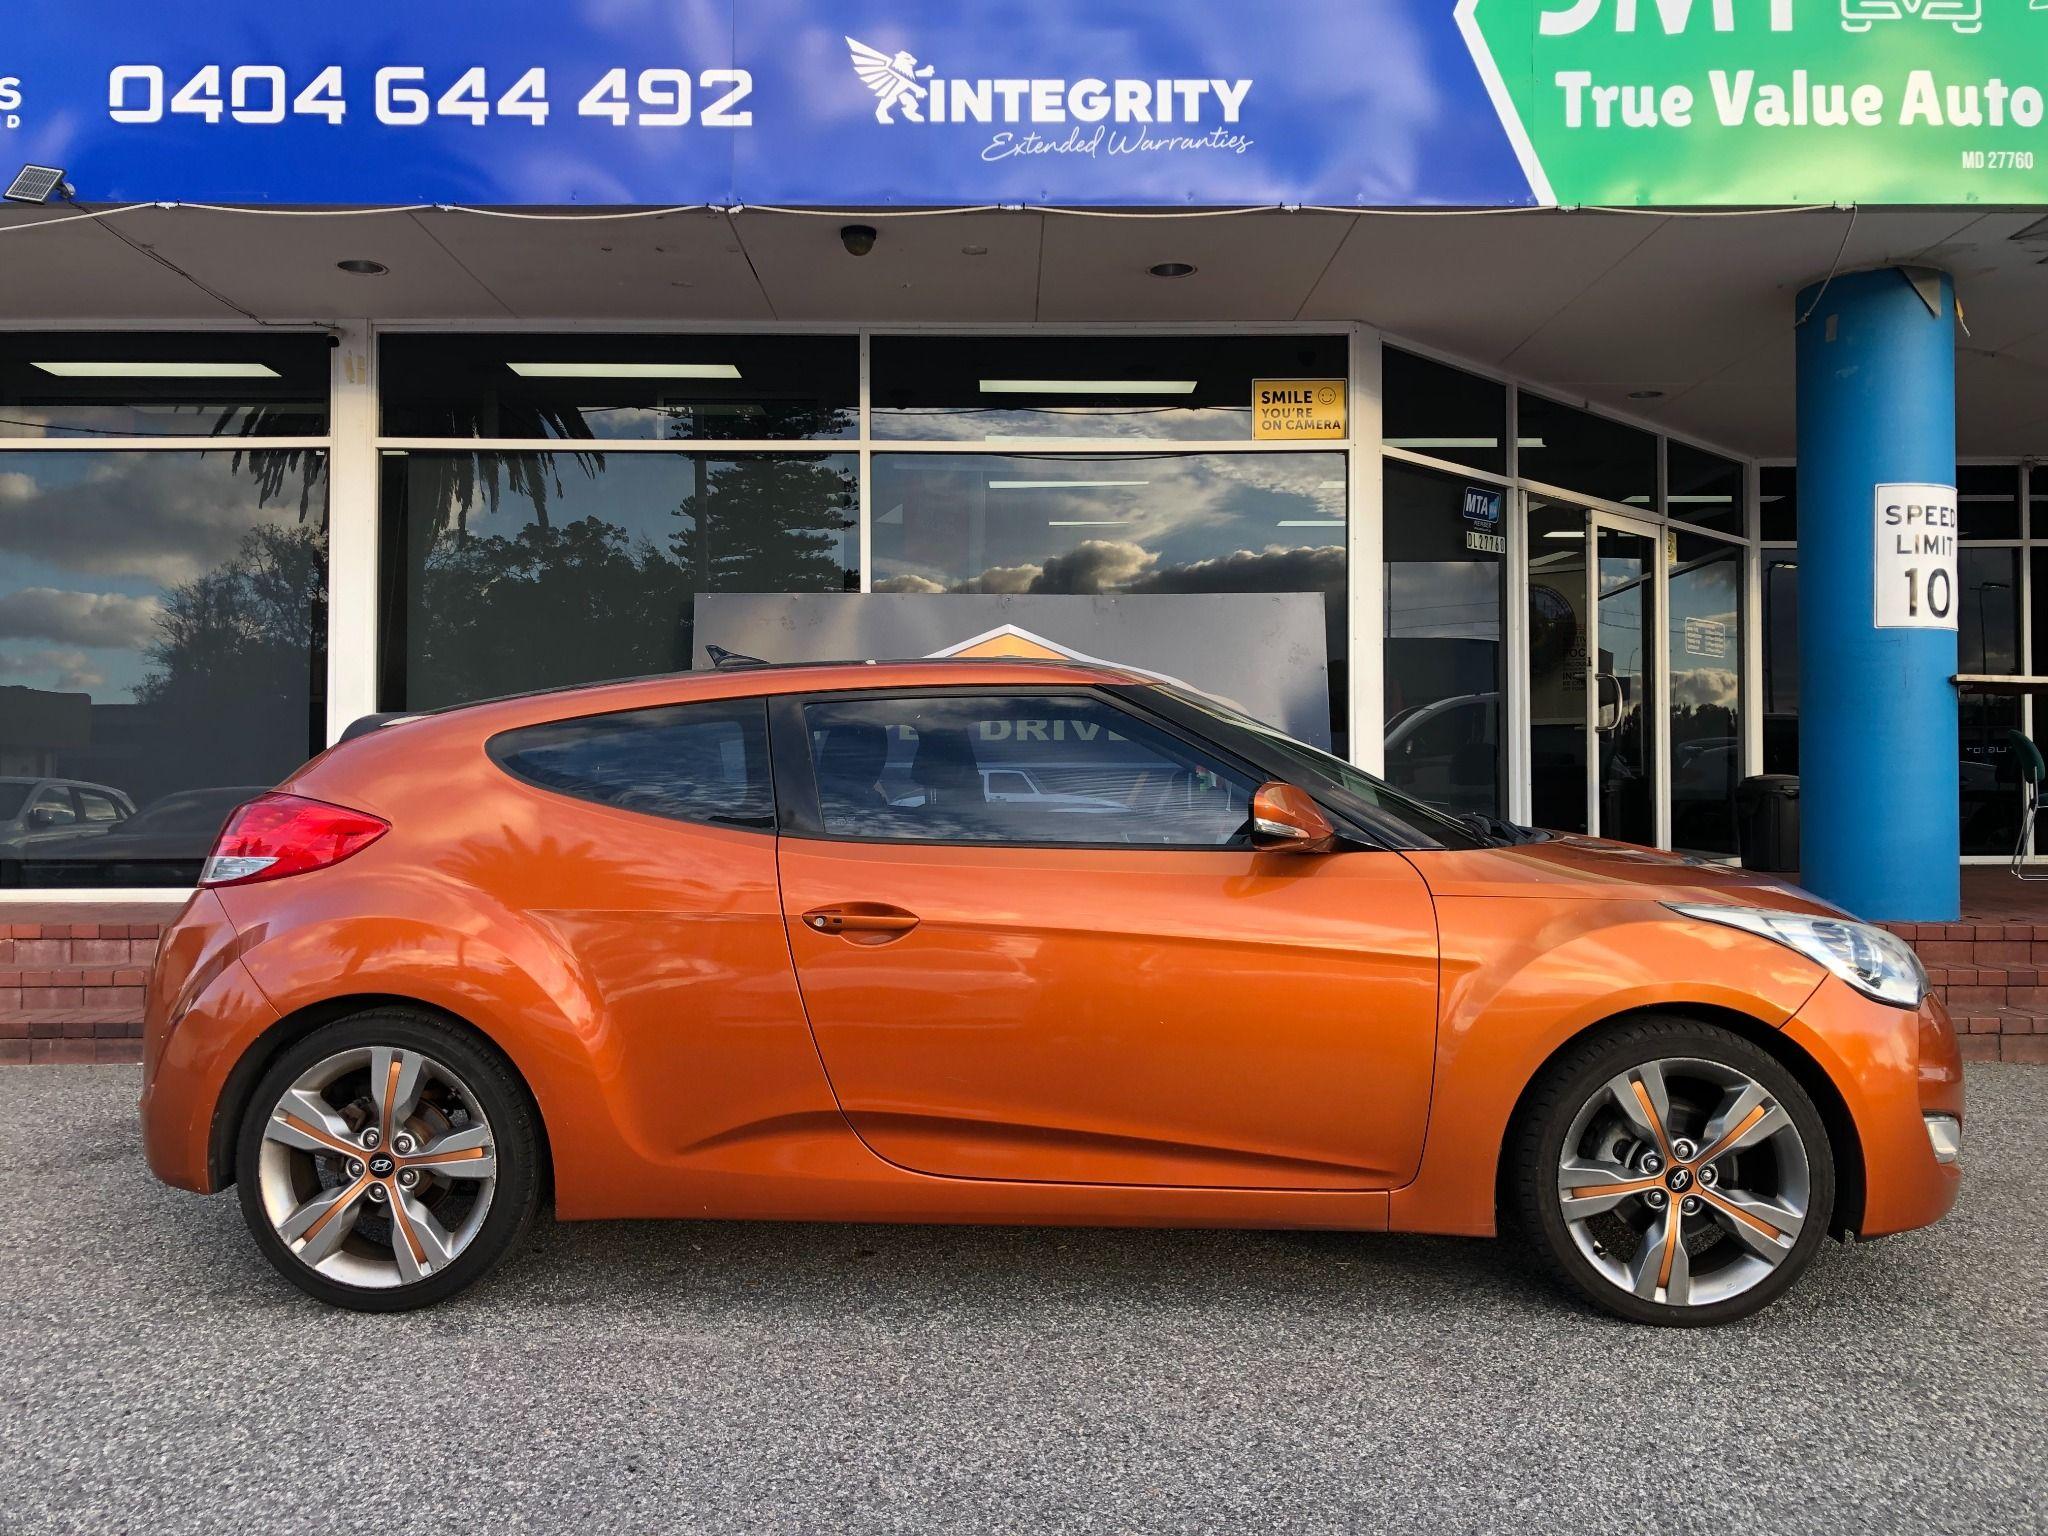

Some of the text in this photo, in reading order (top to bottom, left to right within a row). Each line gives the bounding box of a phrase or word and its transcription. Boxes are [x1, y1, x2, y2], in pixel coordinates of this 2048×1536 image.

[109, 65, 753, 127] 0404 644 492
[930, 79, 1254, 123] INTEGRITY
[1555, 69, 2044, 128] True Value Auto
[982, 126, 1254, 162] Extended Warranties
[1962, 151, 2034, 170] MD 27760
[1261, 390, 1313, 404] SMILE
[1261, 407, 1313, 419] YOU'RE
[1261, 419, 1341, 430] ON CAMERA
[1466, 493, 1488, 515] MTA
[1885, 504, 1956, 528] SPEED
[1896, 534, 1953, 557] LIMIT
[1904, 567, 1951, 619] 10
[979, 720, 1129, 741] DRIV
